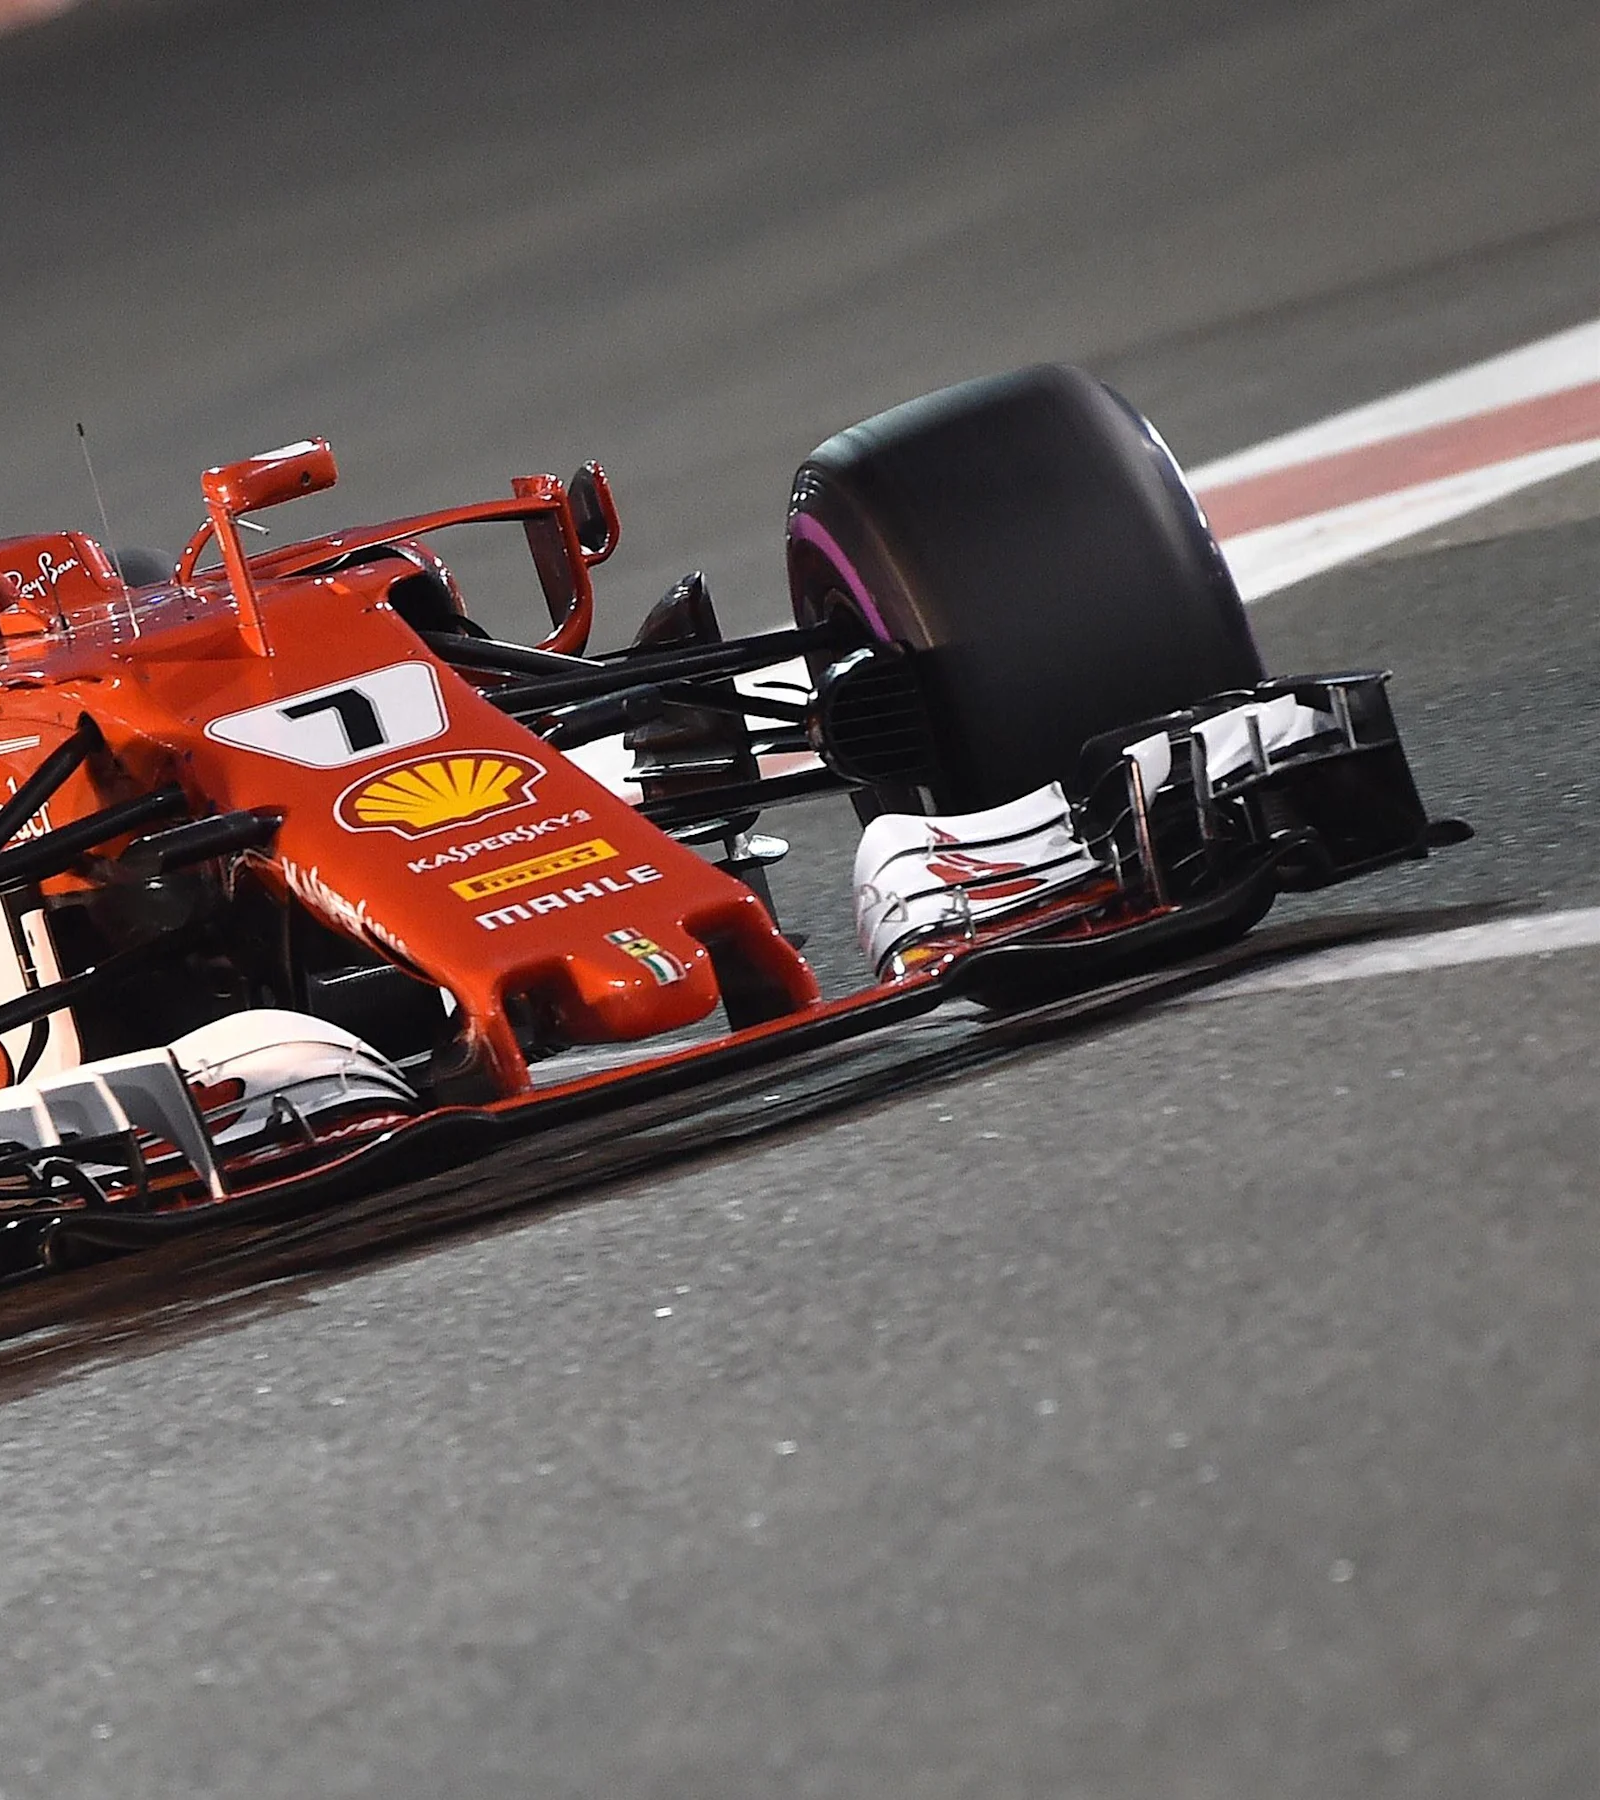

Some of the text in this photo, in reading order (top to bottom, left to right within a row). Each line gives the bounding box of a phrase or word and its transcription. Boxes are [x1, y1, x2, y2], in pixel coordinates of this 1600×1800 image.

[276, 686, 390, 755] 7
[407, 812, 571, 874] KASPERSKY
[475, 864, 664, 931] MAHLE
